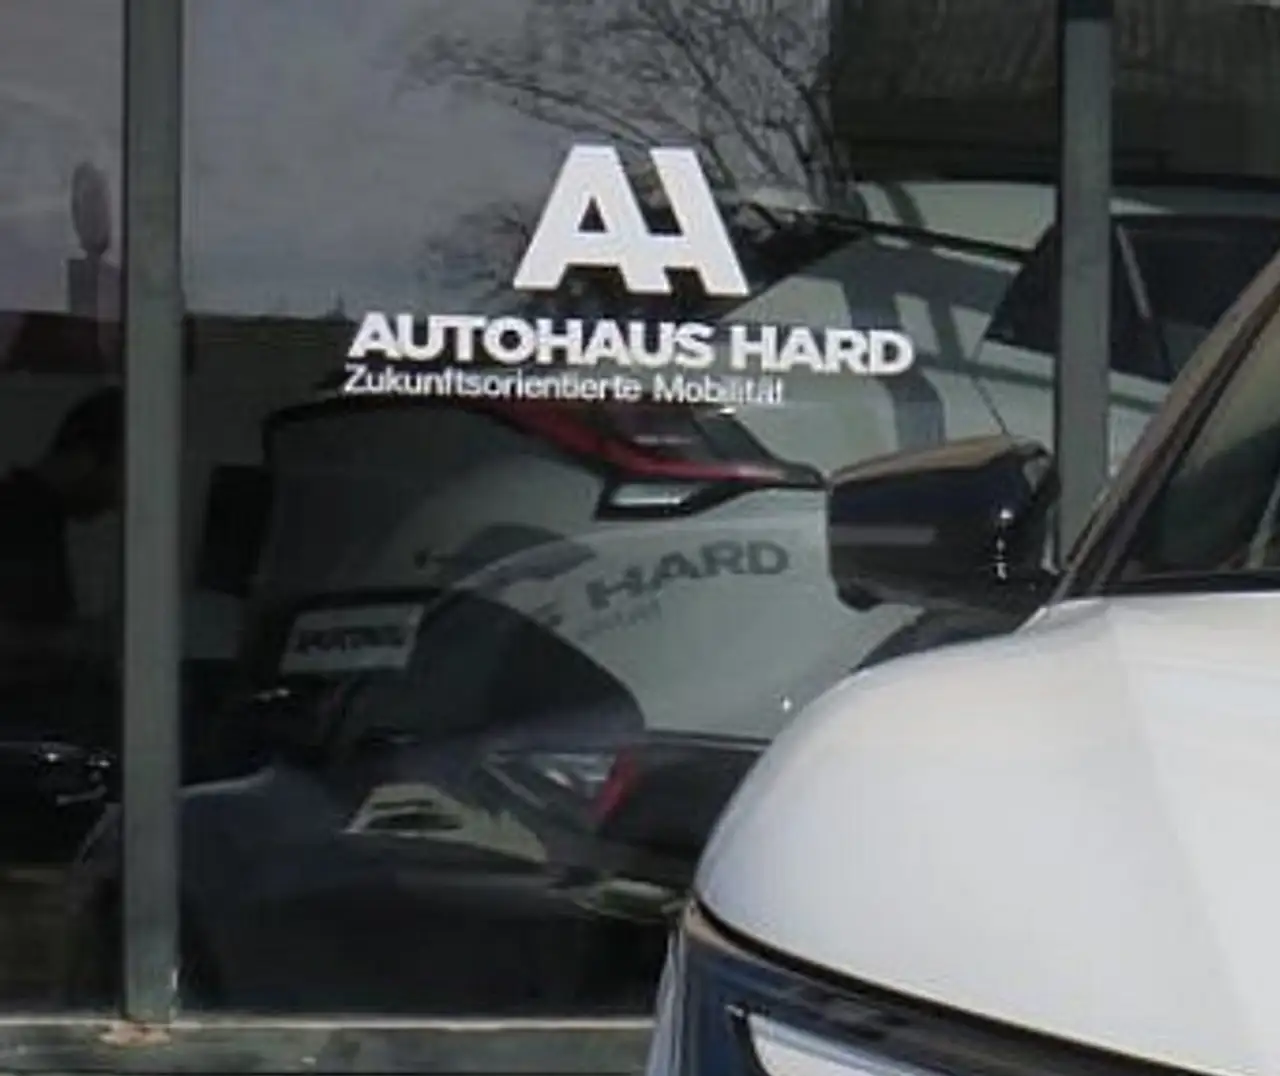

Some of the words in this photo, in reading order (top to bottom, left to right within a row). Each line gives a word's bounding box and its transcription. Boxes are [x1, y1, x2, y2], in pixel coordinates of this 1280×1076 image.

[348, 310, 716, 371] AUTOHAUS
[728, 324, 915, 377] HARD
[344, 362, 643, 401] Zukunftsorientierte
